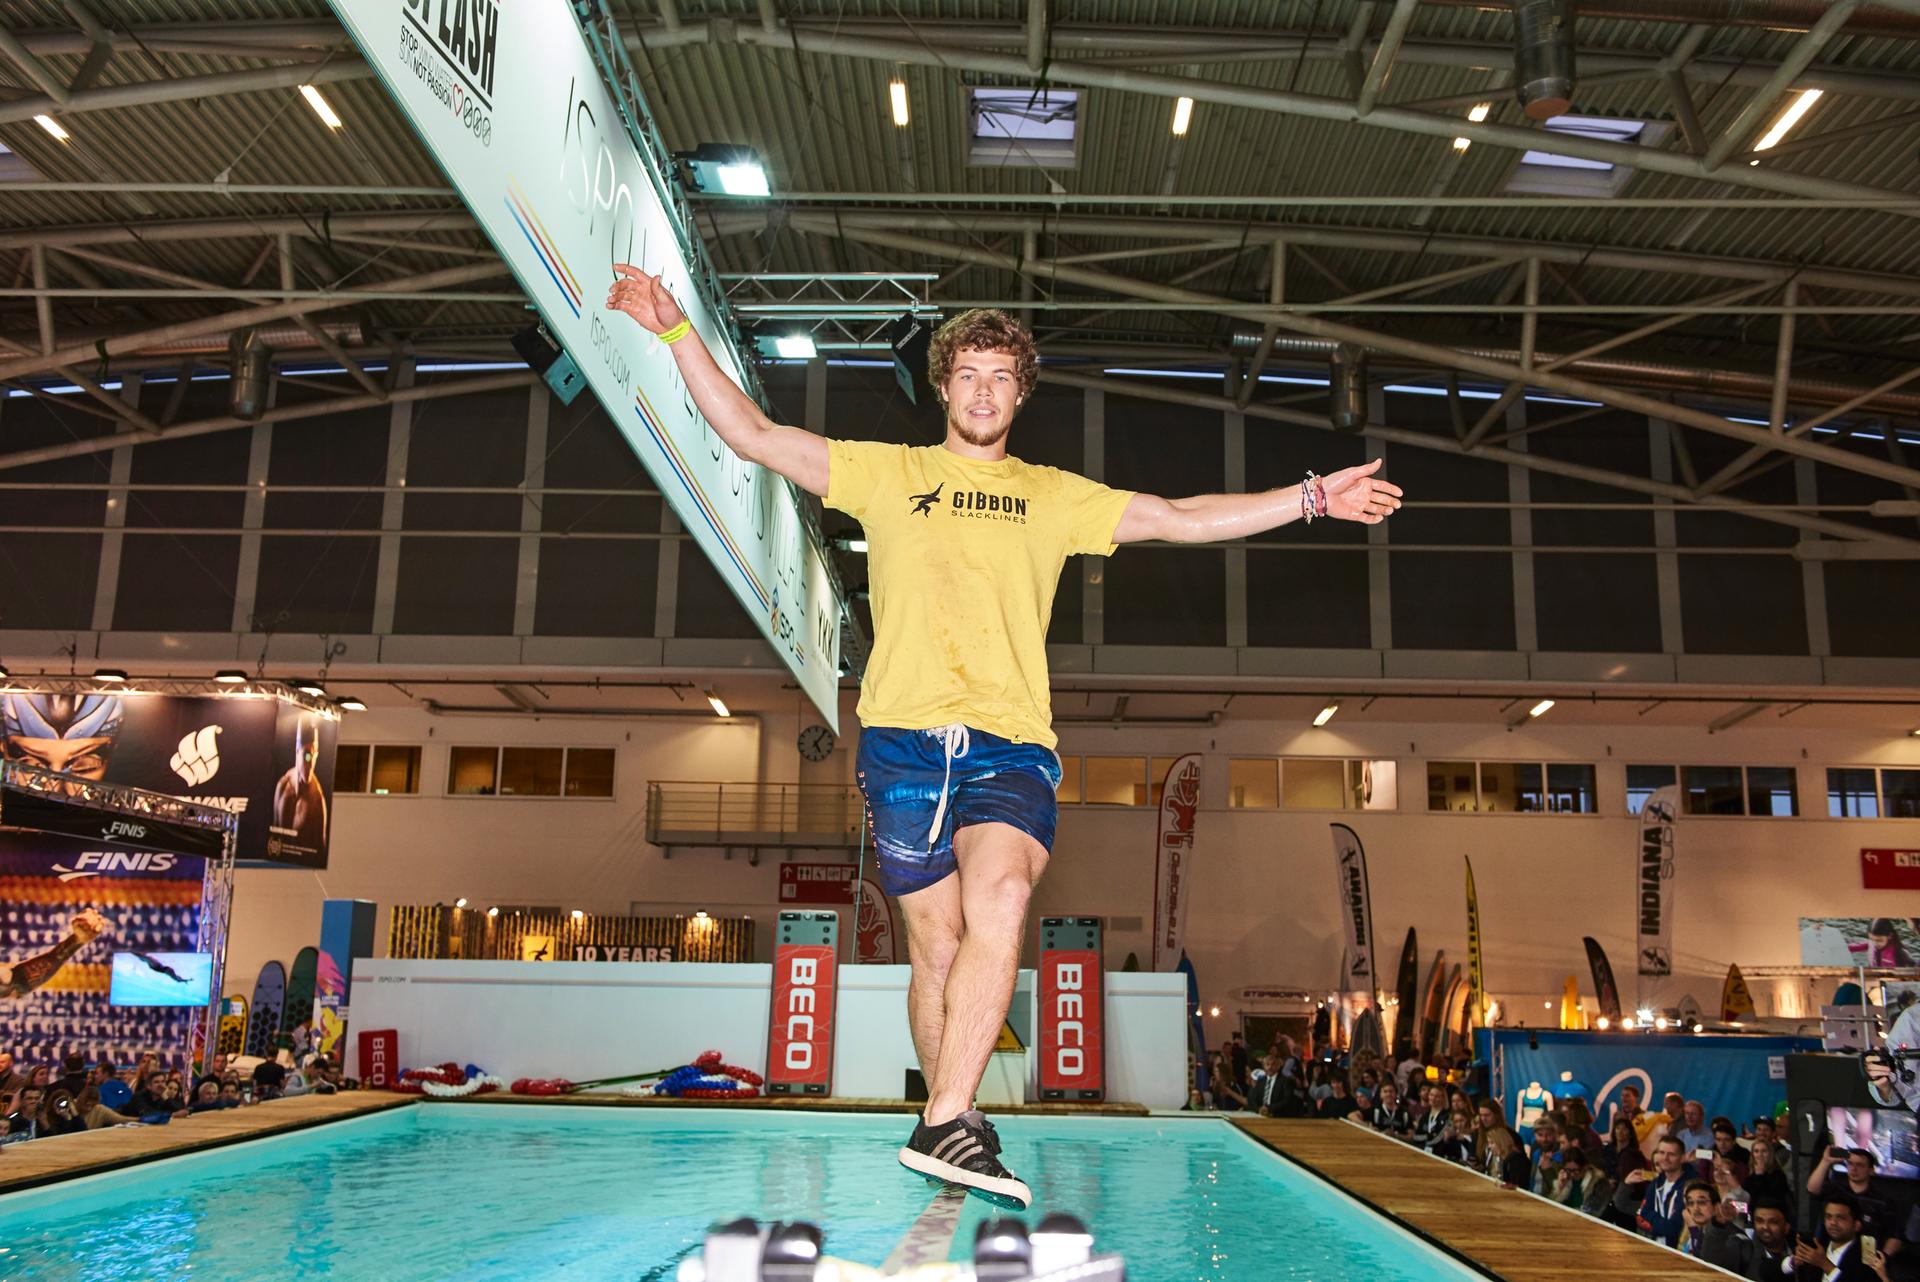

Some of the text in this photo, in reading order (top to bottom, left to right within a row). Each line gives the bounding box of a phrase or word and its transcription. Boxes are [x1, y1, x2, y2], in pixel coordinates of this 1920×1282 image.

[400, 25, 418, 53] STOP
[413, 57, 427, 82] NOT
[427, 71, 452, 110] PASSION
[590, 311, 630, 396] ISPO.COM
[951, 510, 1026, 524] SLACKLINES
[952, 491, 1026, 516] GIBBON
[818, 600, 834, 669] YKK
[111, 822, 146, 838] FINIS
[1661, 826, 1675, 880] SUP
[74, 852, 172, 871] FINIS
[1641, 826, 1662, 936] INDIANA
[576, 946, 671, 962] 10 YEARS
[785, 958, 817, 1069] BECO
[1057, 964, 1083, 1075] BECO
[372, 1037, 385, 1085] BECO
